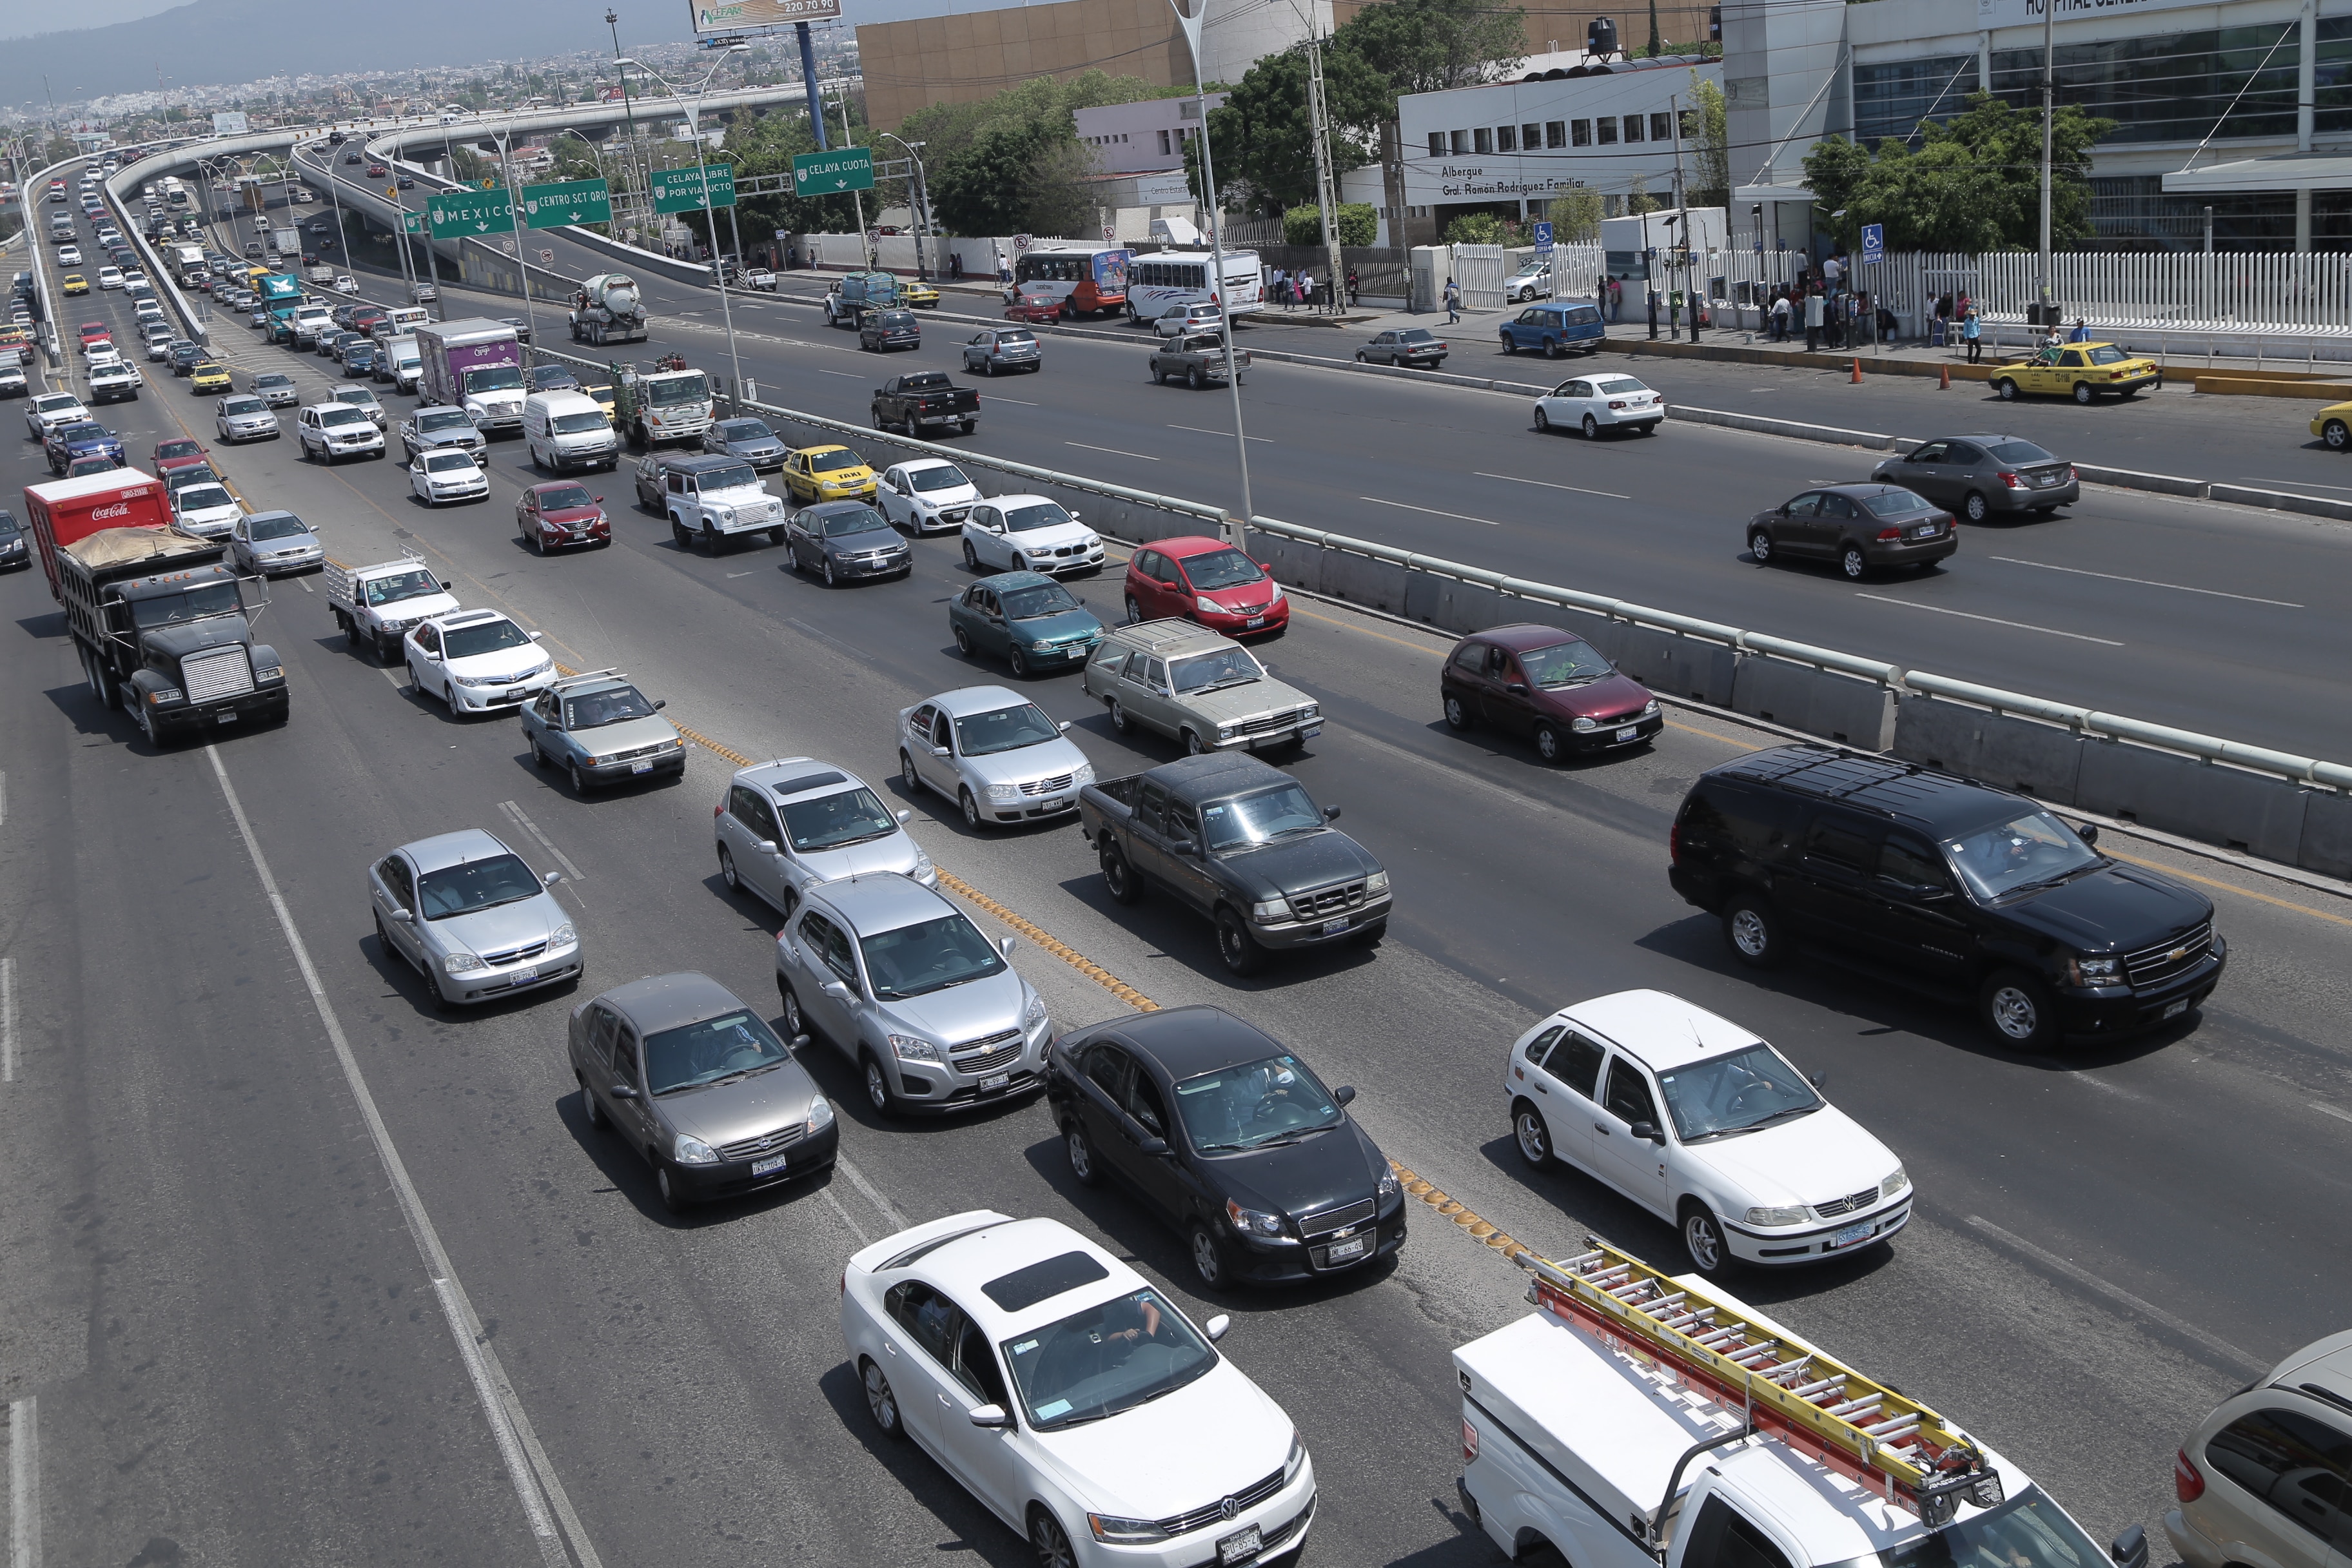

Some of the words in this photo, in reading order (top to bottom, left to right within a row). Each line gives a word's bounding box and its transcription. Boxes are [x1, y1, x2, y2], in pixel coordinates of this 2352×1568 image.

[711, 6, 743, 17] CEFAM
[785, 2, 803, 12] 220
[806, 1, 818, 10] 70
[821, 0, 834, 8] 90
[809, 162, 841, 175] CELAYA
[842, 159, 869, 171] CUOTA
[1442, 166, 1482, 180] Albergue
[667, 172, 701, 184] CELAYA
[669, 188, 687, 198] POR
[688, 182, 731, 195] VIAUCTO
[1443, 184, 1462, 196] Gral.
[1465, 183, 1494, 195] Ramón
[1547, 178, 1585, 190] Familiar
[539, 194, 570, 207] CENTRO
[573, 192, 587, 204] SCT
[591, 190, 607, 202] QRO
[447, 204, 513, 221] MEXICO
[1865, 253, 1877, 262] INICIA
[2055, 373, 2070, 383] TZ-1186
[122, 488, 148, 498] QRO-21930
[92, 502, 128, 521] Coca-Cola
[753, 1159, 785, 1174] UKA-104-S
